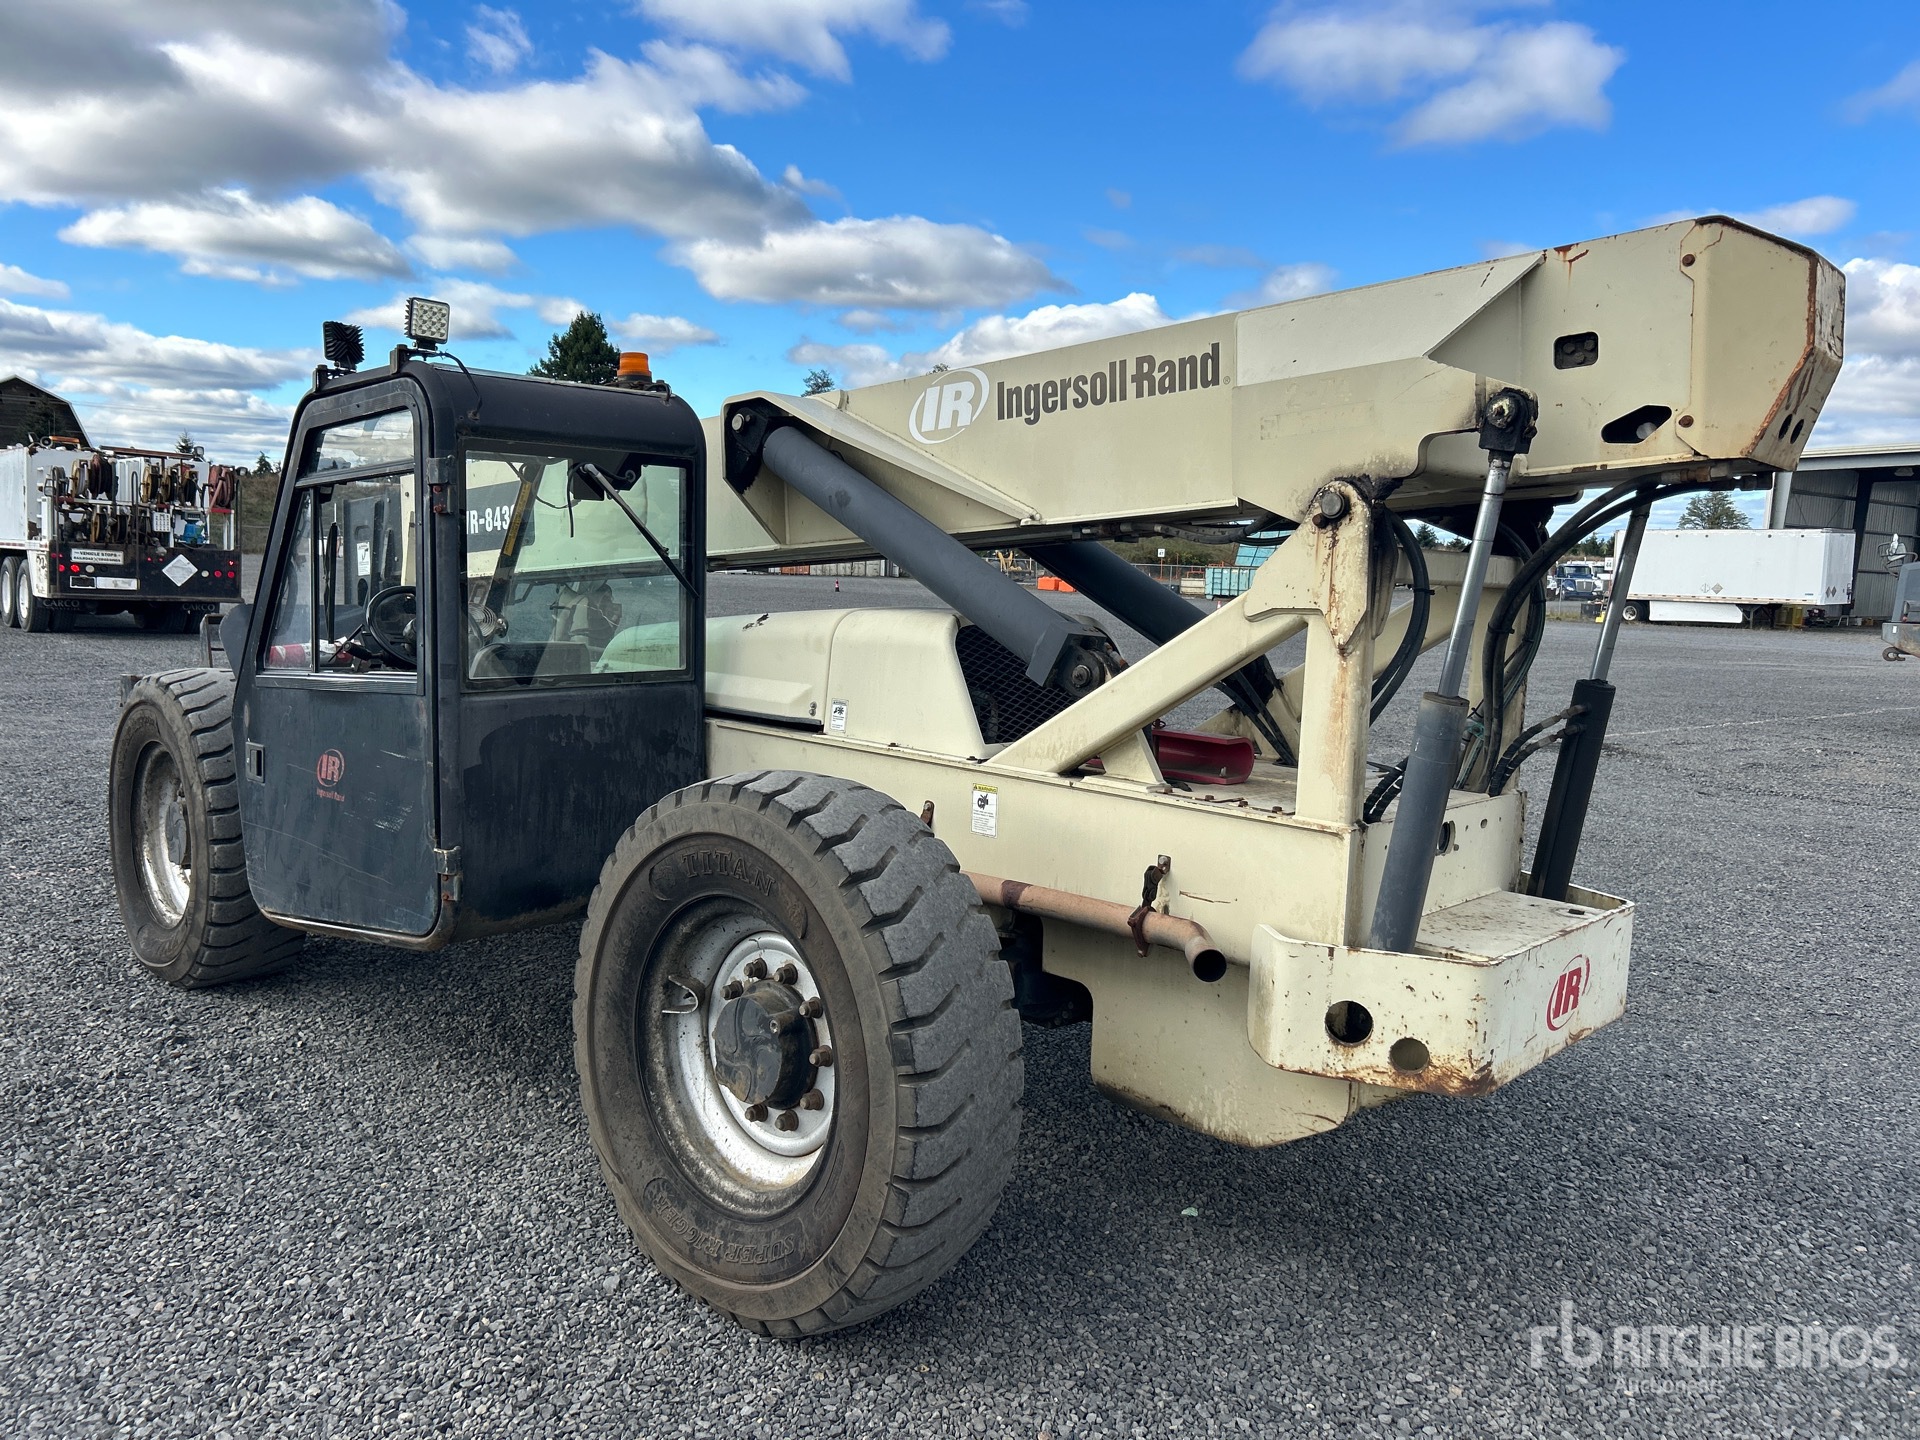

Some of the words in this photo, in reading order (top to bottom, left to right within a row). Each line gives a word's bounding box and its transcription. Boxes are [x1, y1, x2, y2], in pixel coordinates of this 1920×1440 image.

[921, 380, 976, 433] IR
[996, 359, 1128, 426] Ingersoll
[1131, 341, 1221, 400] Rand
[43, 600, 80, 608] CARCO
[182, 602, 216, 612] CARCO
[320, 754, 340, 782] IR
[681, 849, 776, 897] TITAN
[1552, 966, 1583, 1021] IR
[654, 1194, 724, 1258] RIGGER
[723, 1233, 796, 1265] SUPER
